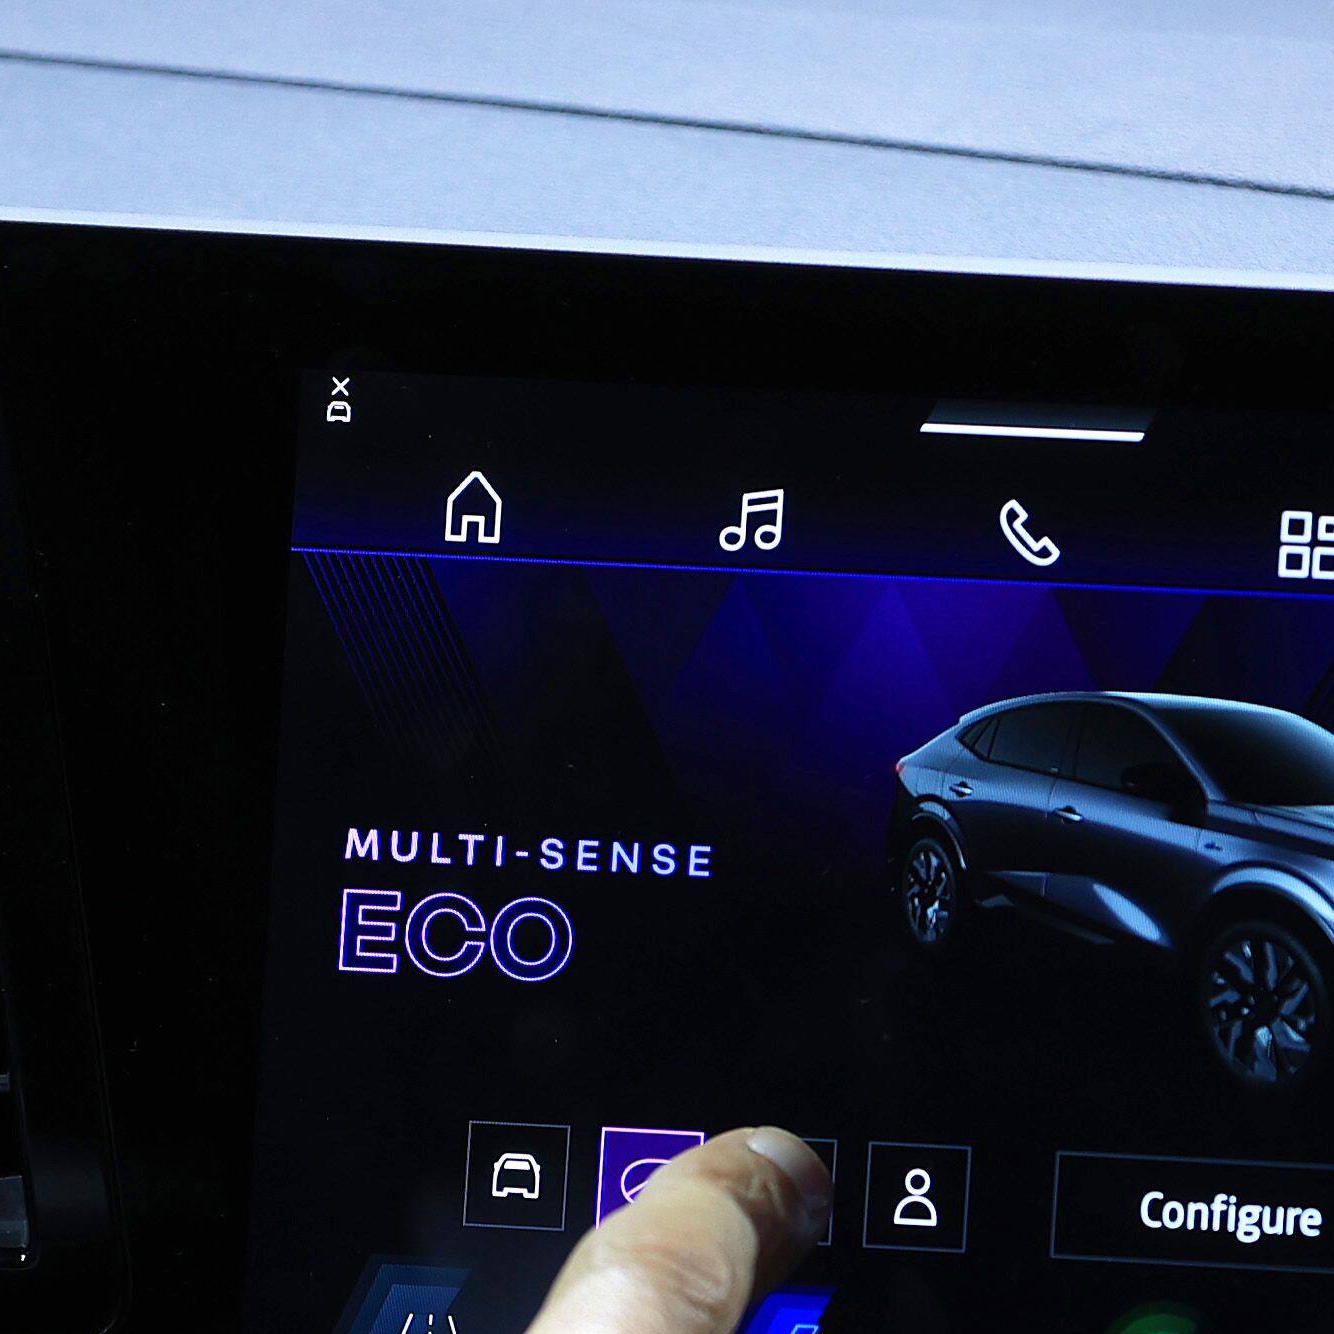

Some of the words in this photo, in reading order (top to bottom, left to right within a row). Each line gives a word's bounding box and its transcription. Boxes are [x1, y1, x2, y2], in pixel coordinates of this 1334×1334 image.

[344, 824, 714, 879] MULTI-SENSE
[336, 888, 576, 983] ECO
[1139, 1190, 1323, 1244] Configure
